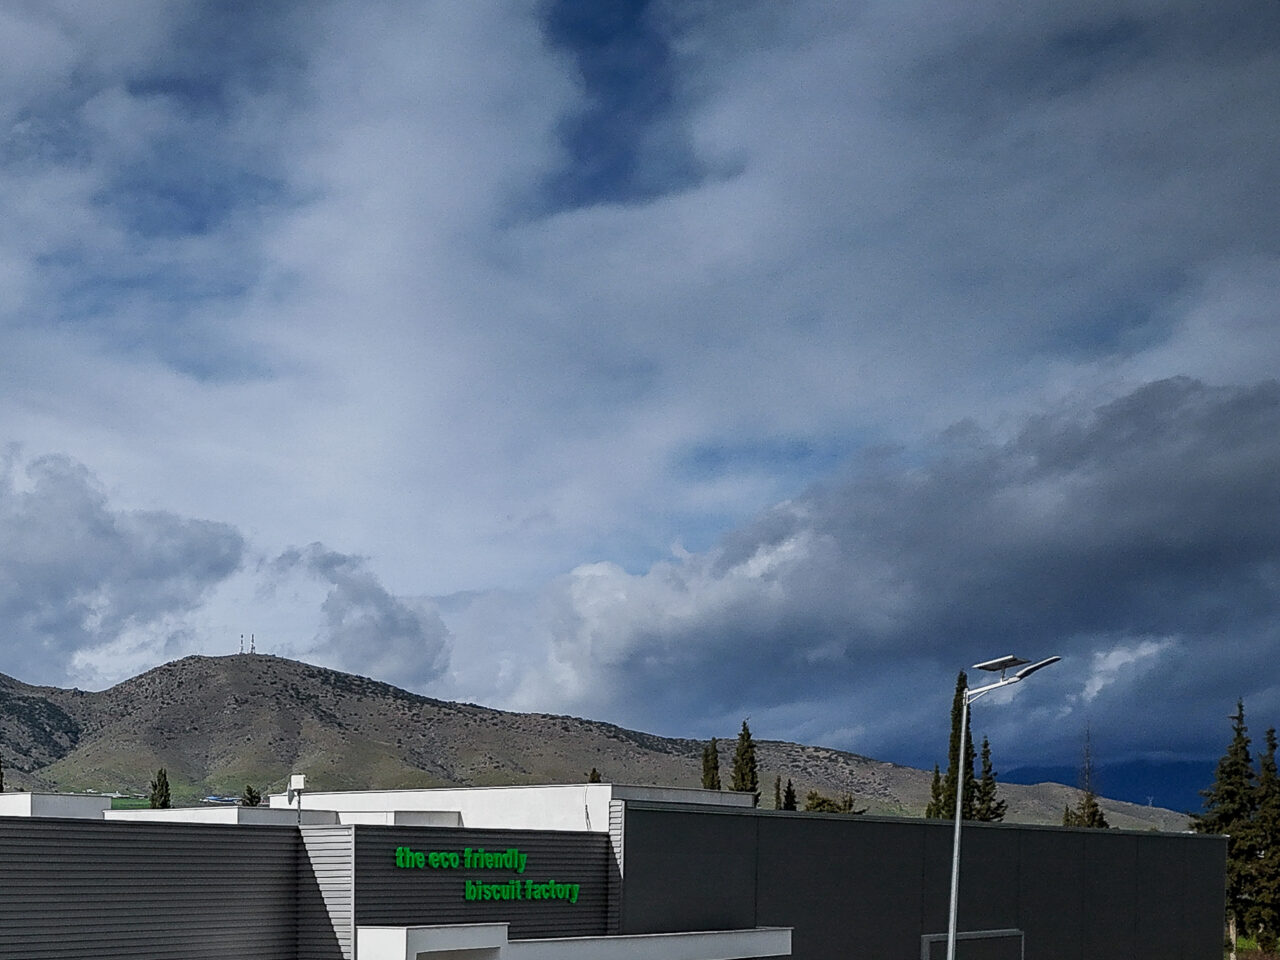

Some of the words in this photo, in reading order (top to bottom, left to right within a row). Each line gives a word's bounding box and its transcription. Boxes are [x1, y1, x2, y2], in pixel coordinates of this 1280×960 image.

[395, 846, 425, 869] the
[428, 851, 460, 869] eco
[464, 847, 528, 873] friendly
[465, 880, 521, 901] biscuit
[524, 880, 580, 904] factory
